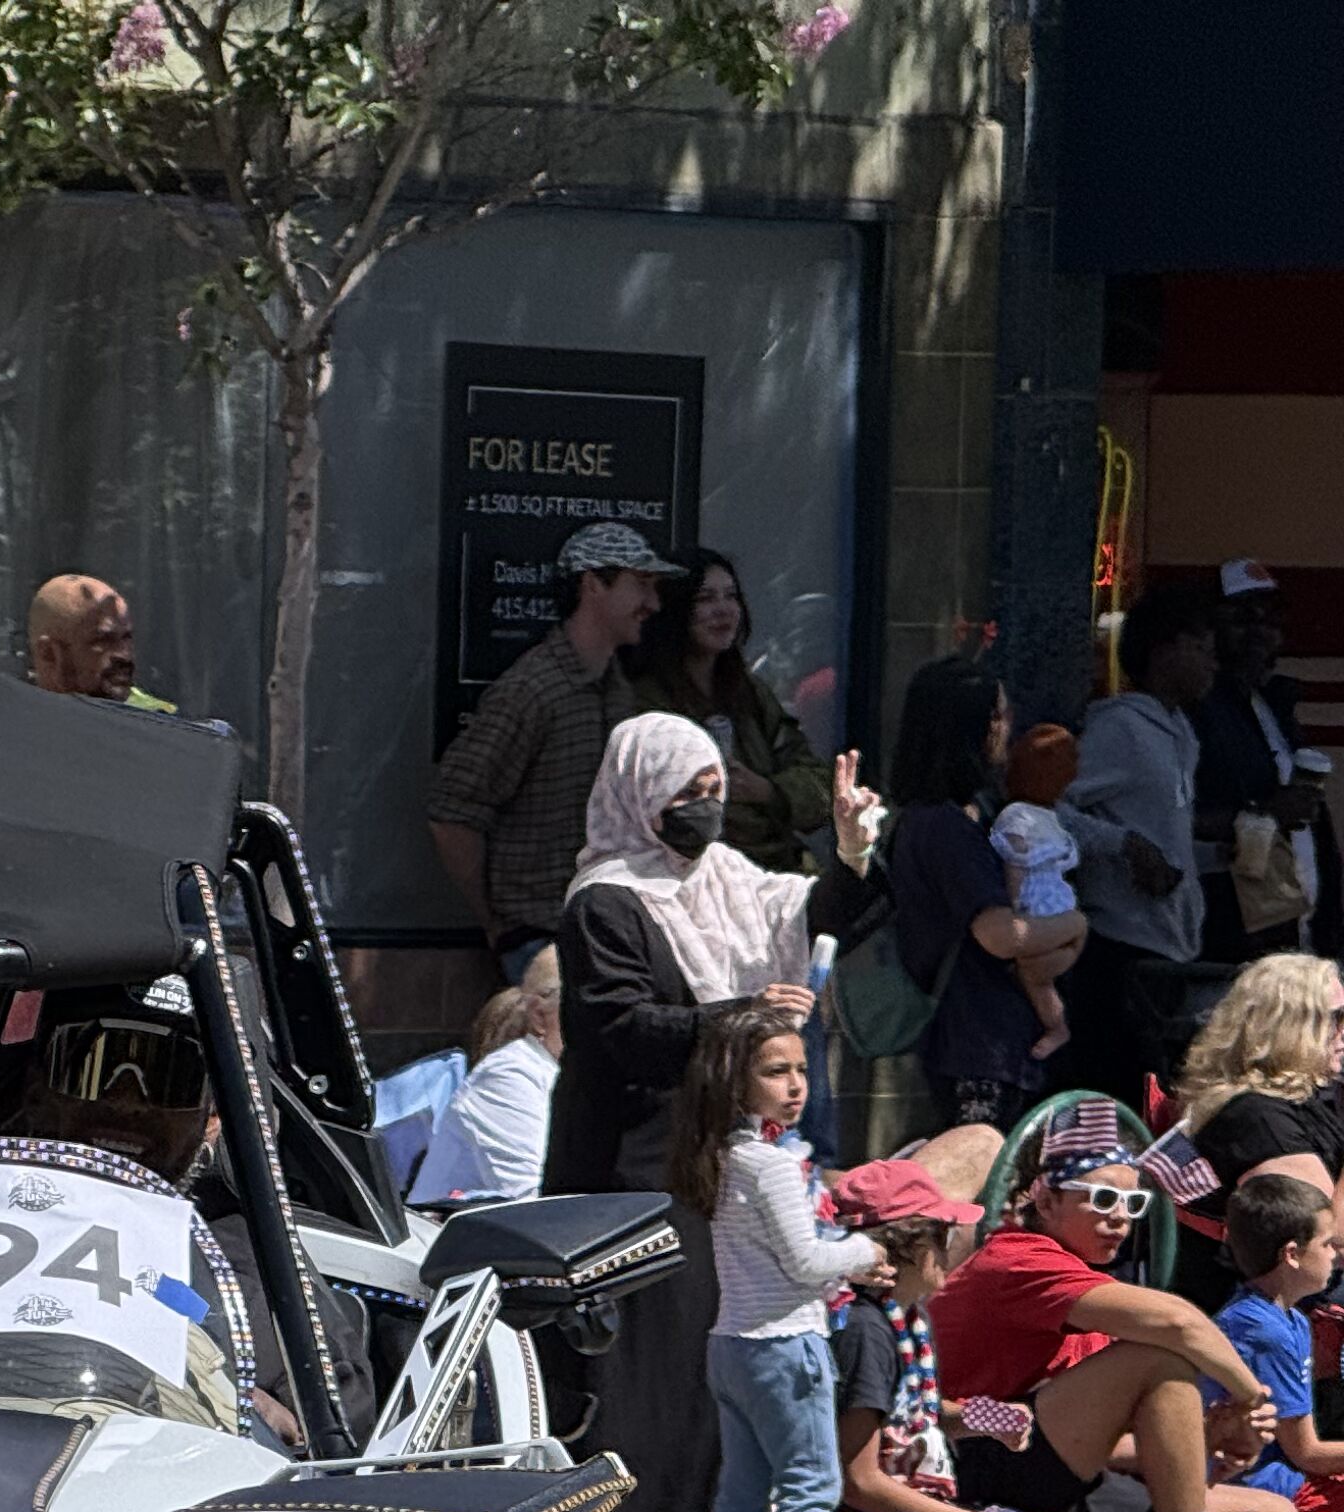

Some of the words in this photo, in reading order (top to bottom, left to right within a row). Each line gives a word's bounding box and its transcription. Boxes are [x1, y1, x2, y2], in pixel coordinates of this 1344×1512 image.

[468, 437, 524, 473] FOR
[532, 440, 613, 478] LEASE
[521, 495, 543, 518] SQ
[566, 497, 613, 518] RETAIL
[617, 499, 664, 521] SPACE
